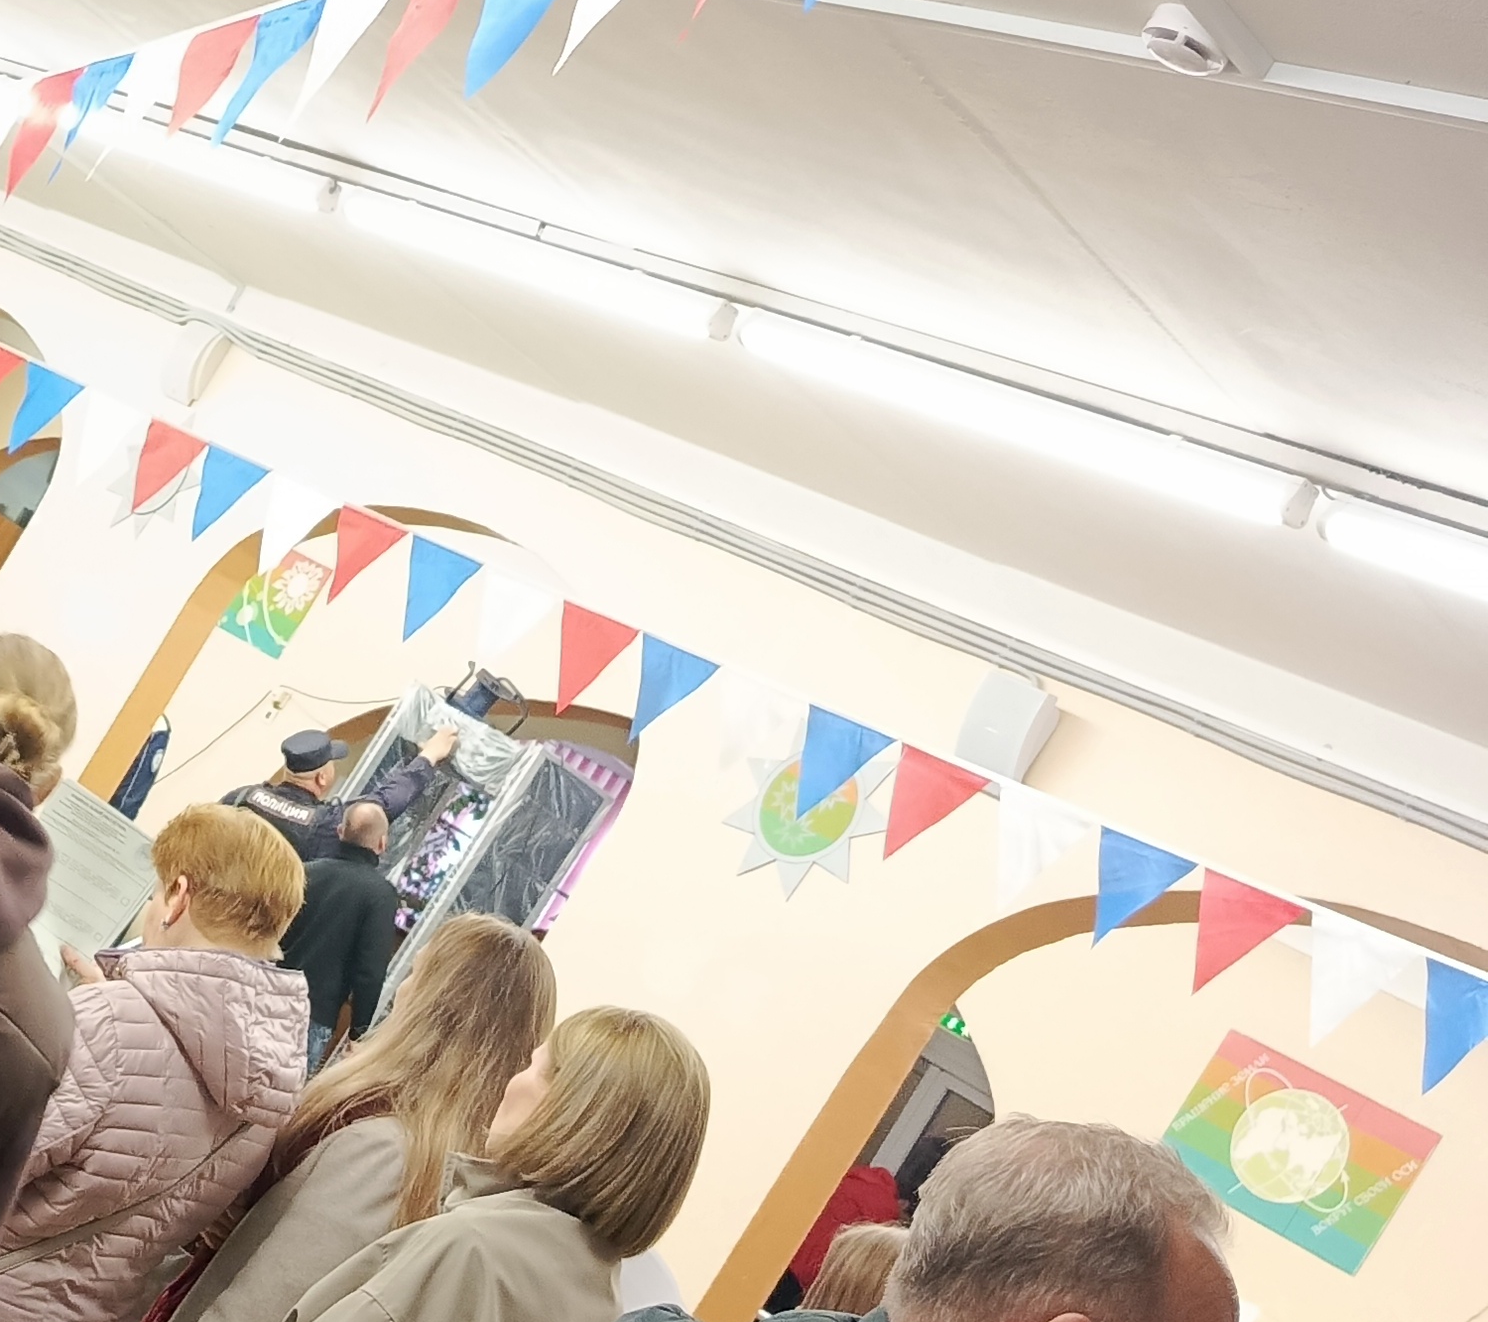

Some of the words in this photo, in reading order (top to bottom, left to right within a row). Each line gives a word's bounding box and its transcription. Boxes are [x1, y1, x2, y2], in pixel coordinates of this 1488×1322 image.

[251, 791, 309, 821] ПОЛИЦИЯ
[1311, 1200, 1353, 1236] ВОКРУГ
[1391, 1159, 1418, 1181] ОСИ
